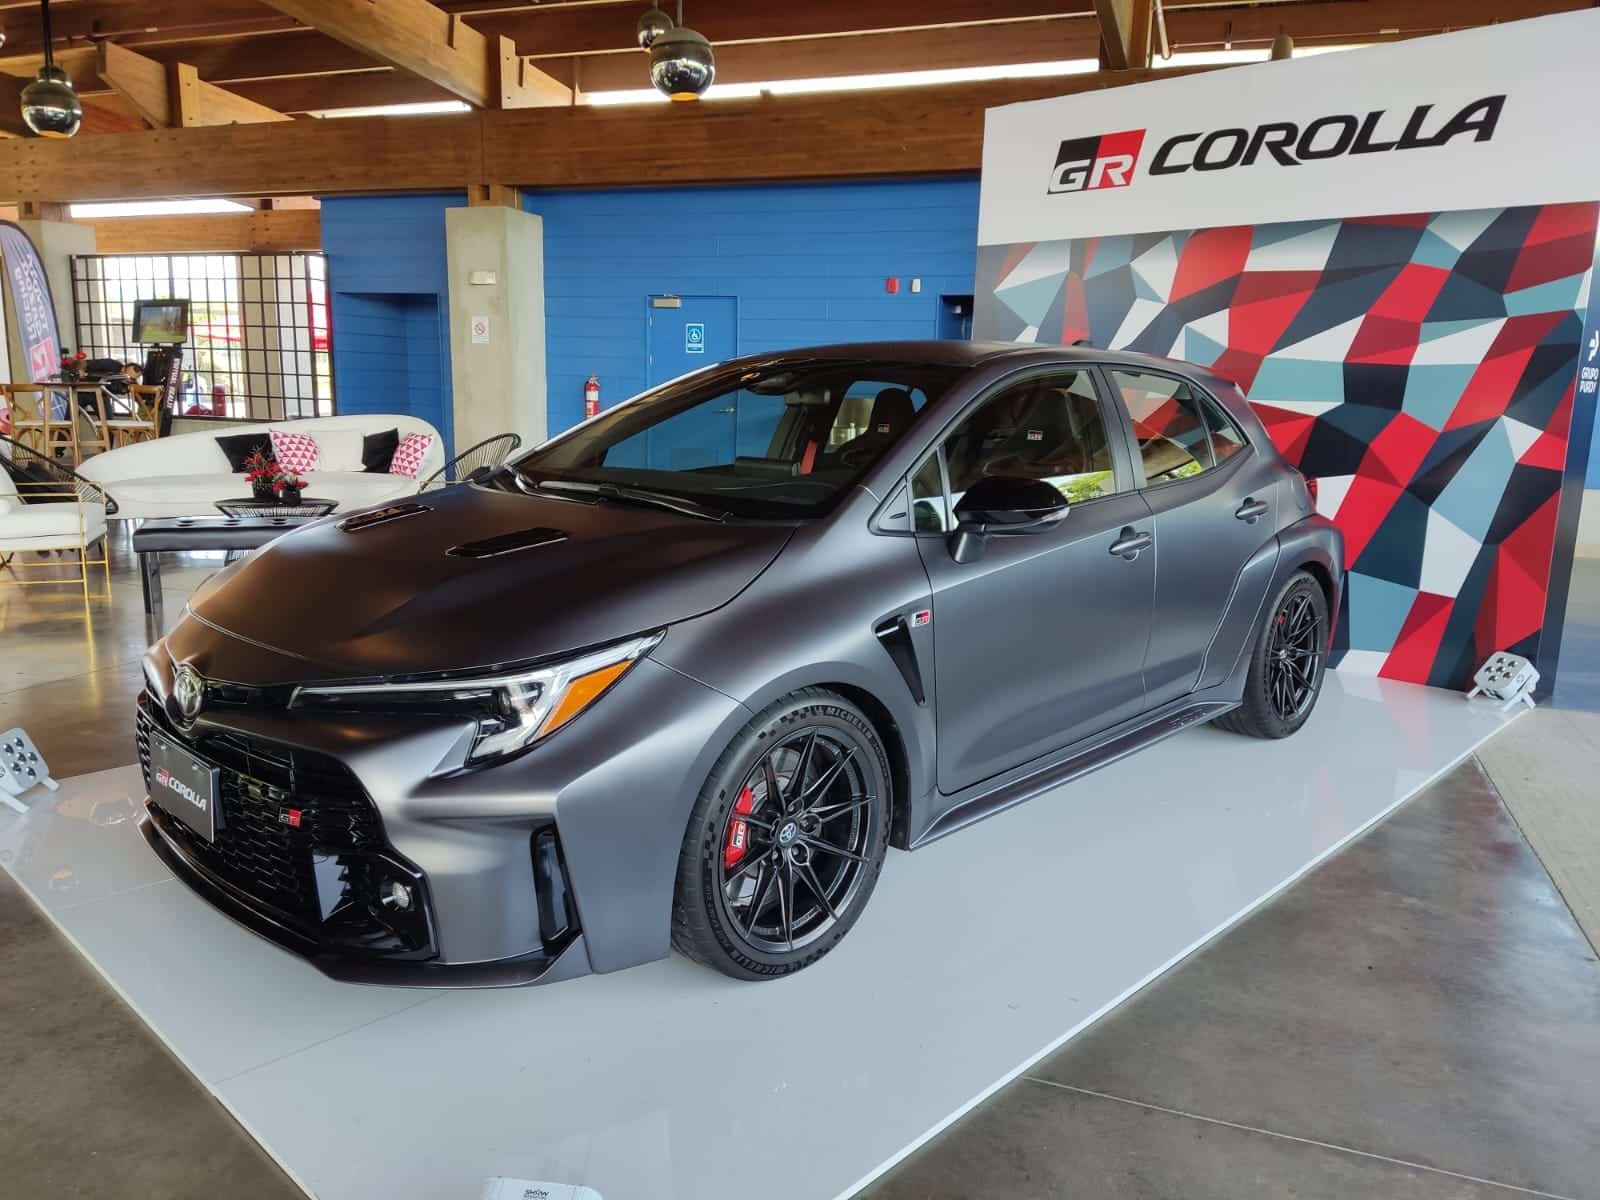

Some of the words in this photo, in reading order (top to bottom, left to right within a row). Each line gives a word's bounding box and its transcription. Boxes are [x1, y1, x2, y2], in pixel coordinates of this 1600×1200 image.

[1047, 152, 1136, 193] GR
[1148, 94, 1507, 176] COROLLA
[168, 776, 207, 811] COROLLA
